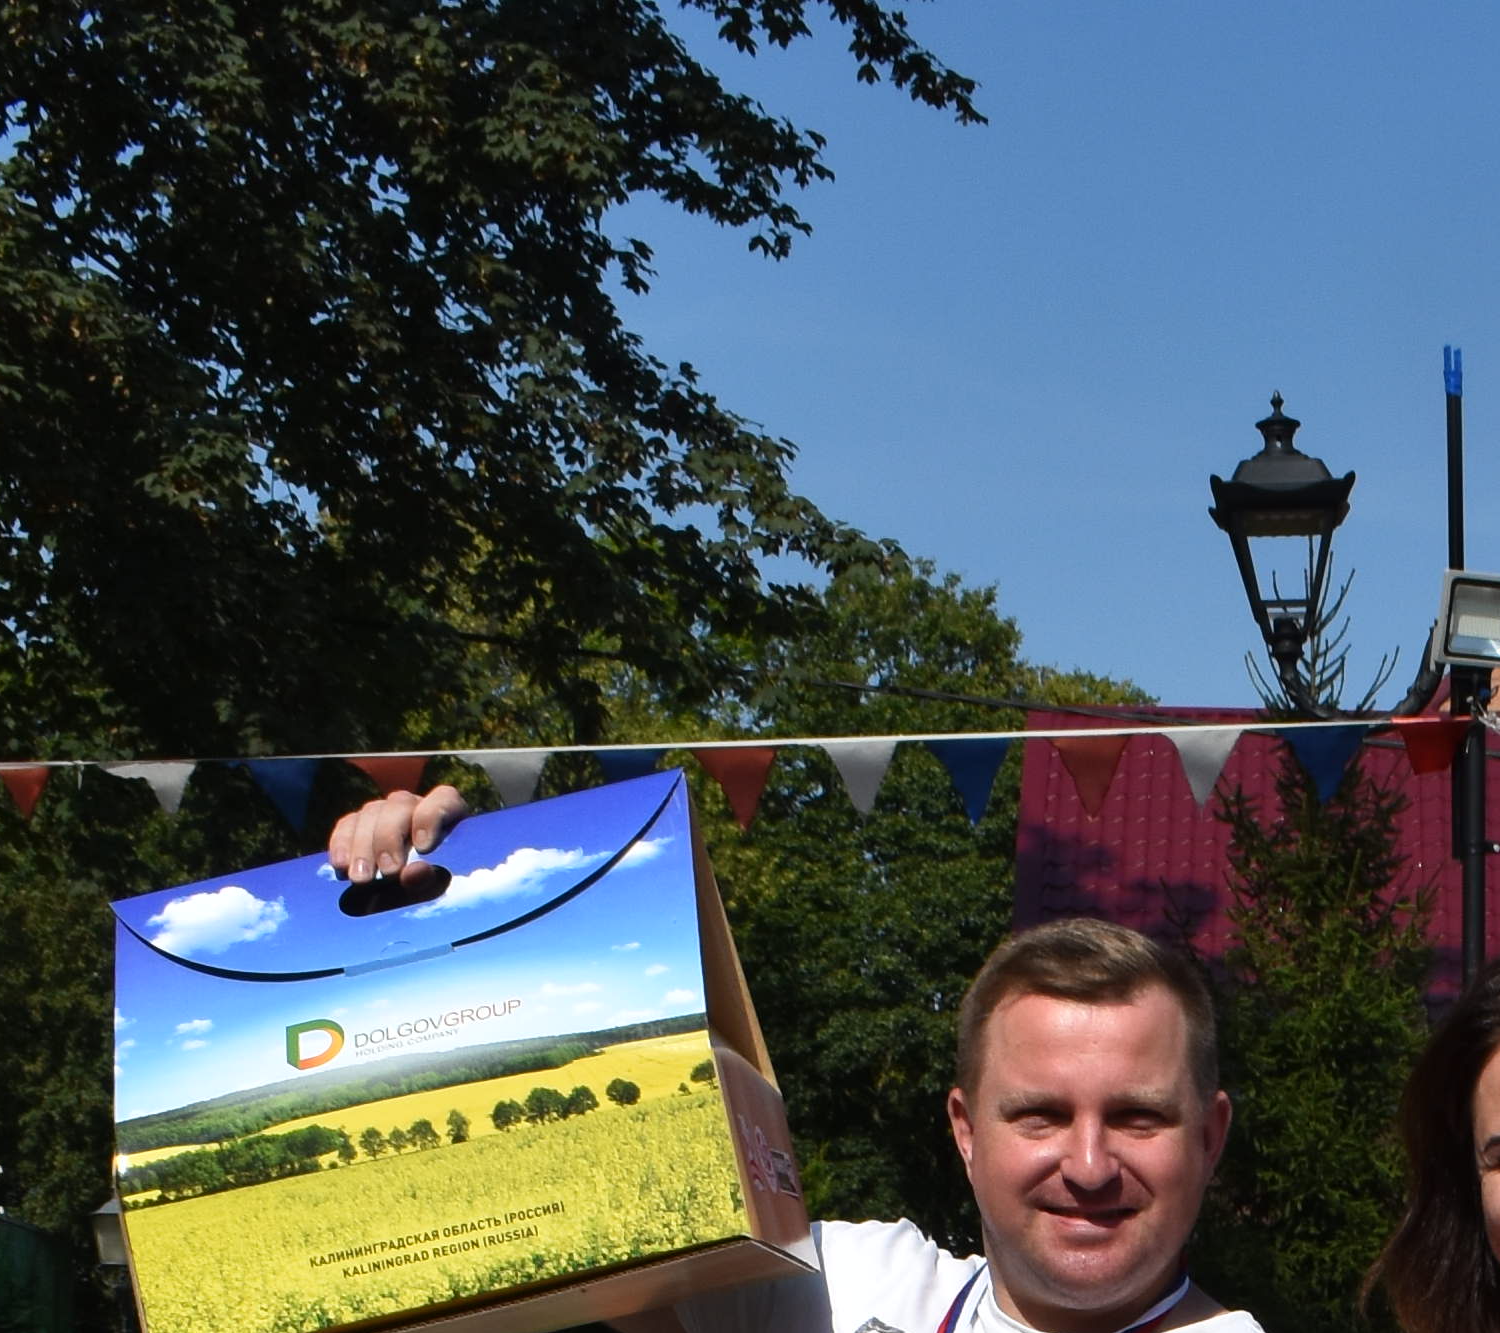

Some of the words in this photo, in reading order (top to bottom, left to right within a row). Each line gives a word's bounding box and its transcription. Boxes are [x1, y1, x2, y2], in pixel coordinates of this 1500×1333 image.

[354, 999, 521, 1048] DOLGOVGROUP
[310, 1230, 439, 1267] КАЛИНИНГРАДСКАЯ
[443, 1218, 501, 1239] ОБЛАСТЬ
[505, 1201, 565, 1224] (РОССИЯ)
[343, 1250, 429, 1278] KALININGRAD
[433, 1239, 479, 1258] REGION
[483, 1225, 538, 1247] (RUSSIA)
